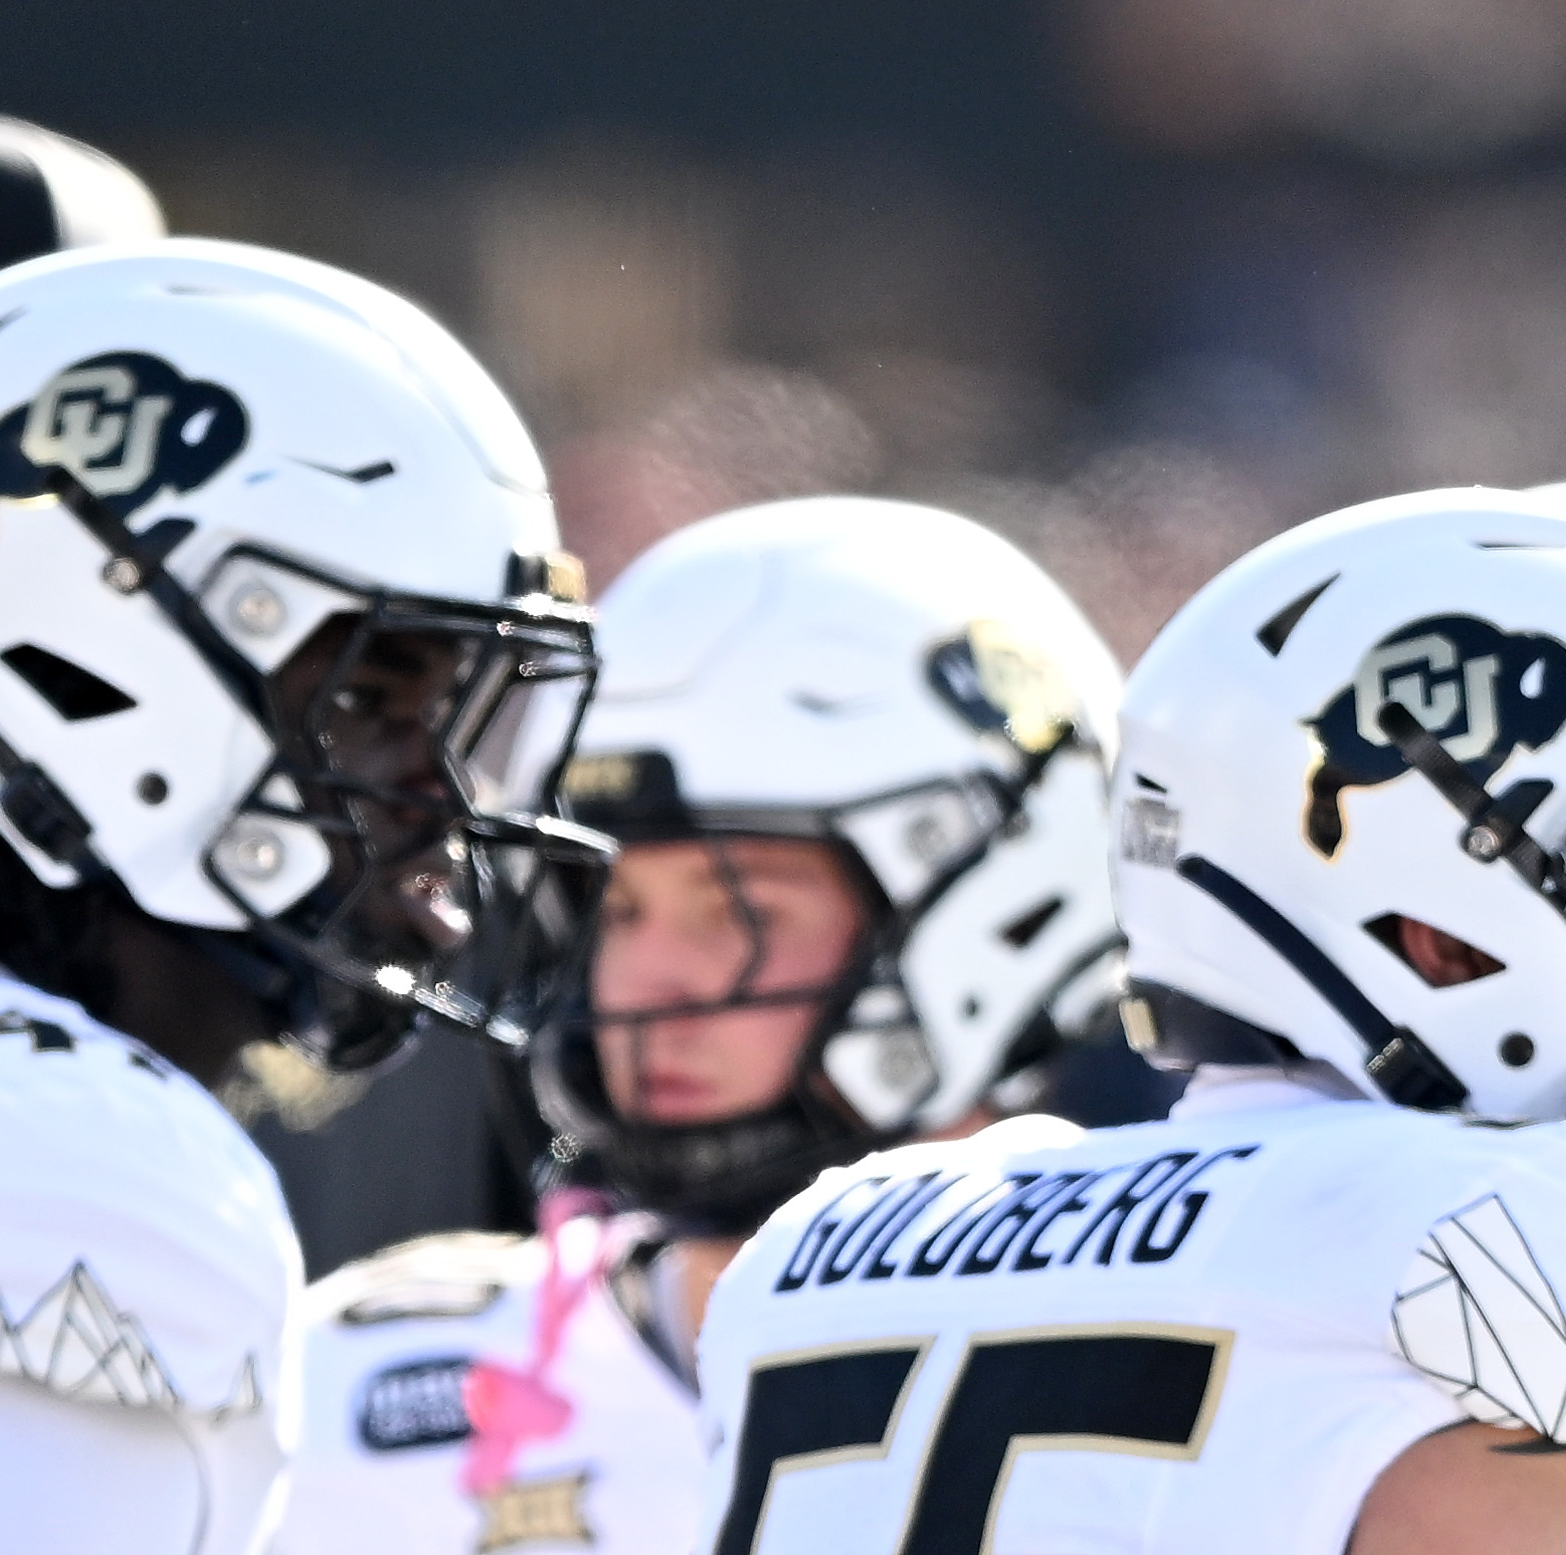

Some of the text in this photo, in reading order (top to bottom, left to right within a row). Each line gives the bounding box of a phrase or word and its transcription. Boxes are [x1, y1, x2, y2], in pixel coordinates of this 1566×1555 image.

[20, 366, 175, 498] CU
[1353, 632, 1499, 764] CU
[775, 1145, 1261, 1293] GOLDBERG
